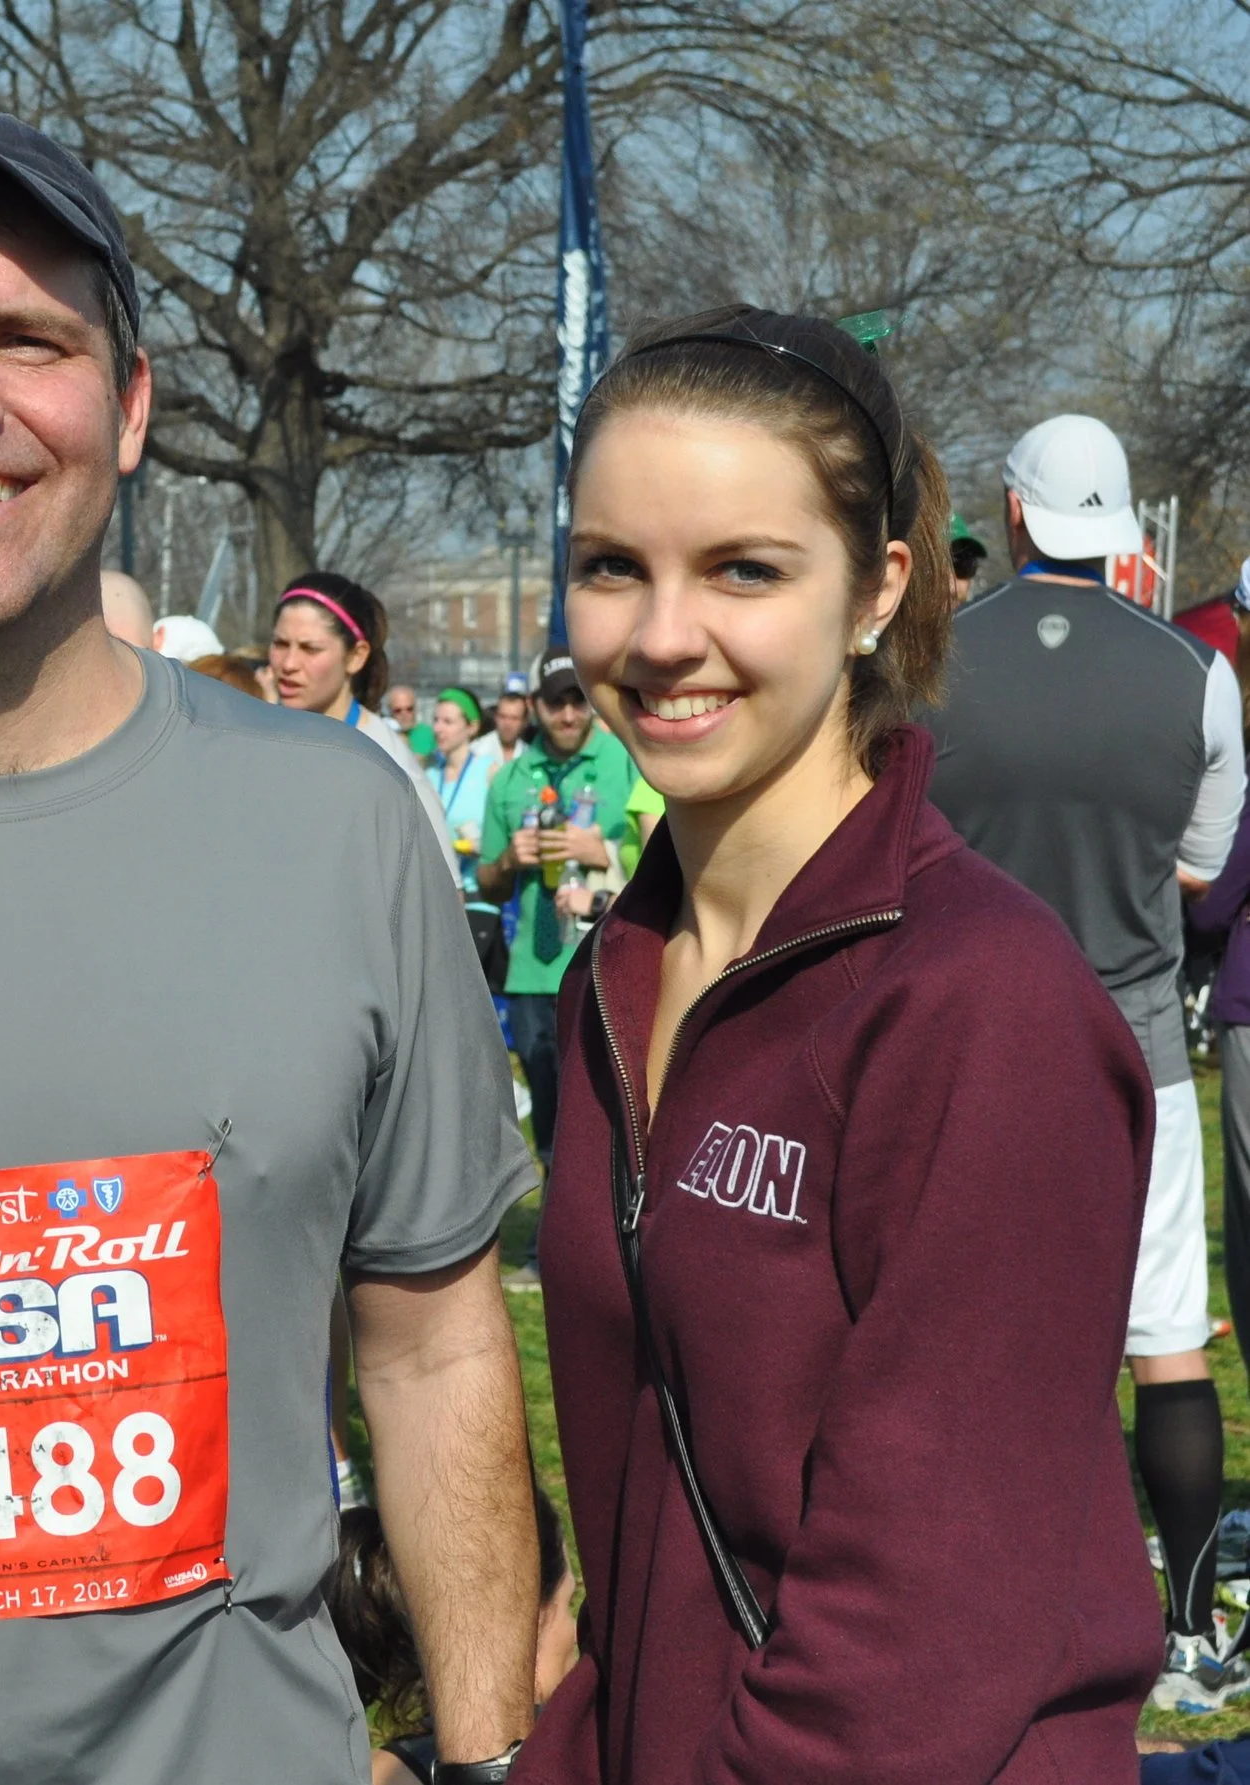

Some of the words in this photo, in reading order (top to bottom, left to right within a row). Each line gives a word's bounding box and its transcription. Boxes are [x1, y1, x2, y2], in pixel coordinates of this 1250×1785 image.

[43, 1220, 190, 1271] Roll
[37, 1554, 113, 1569] CAPITAL
[30, 1585, 66, 1608] 17,
[74, 1578, 129, 1604] 2012
